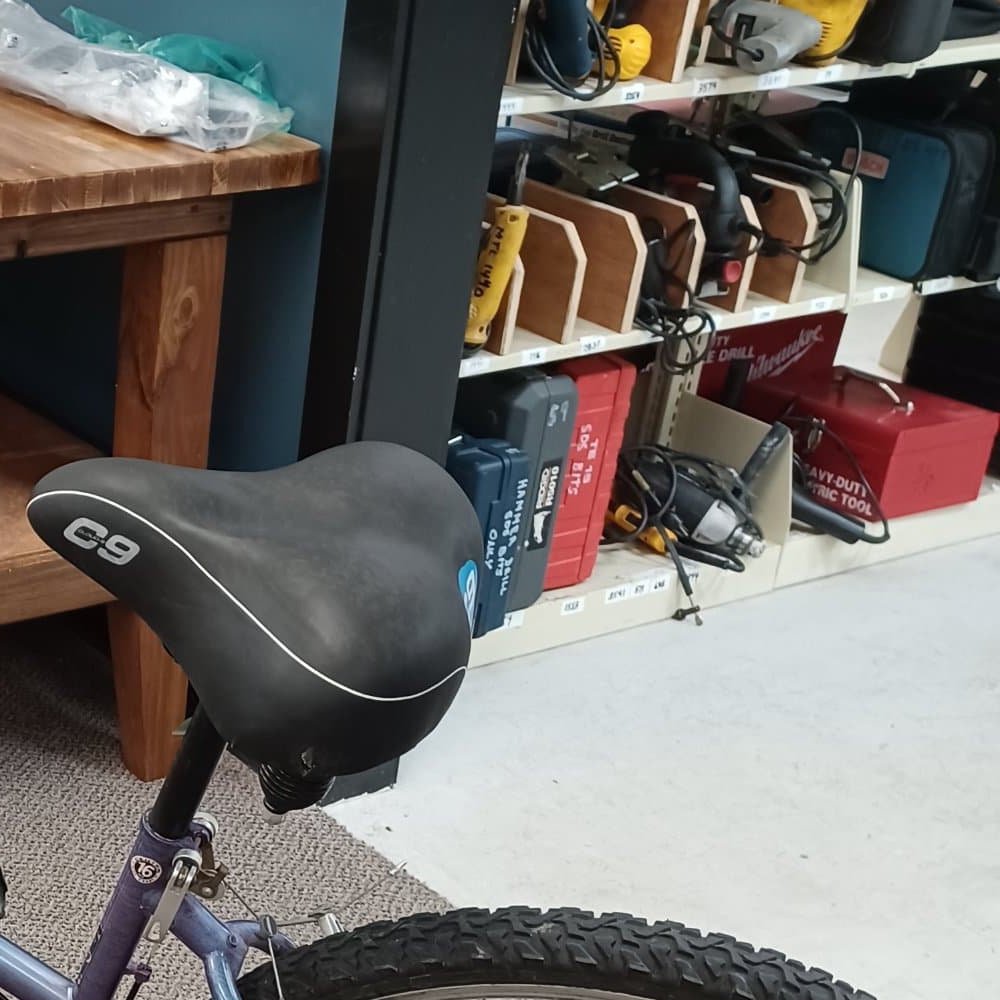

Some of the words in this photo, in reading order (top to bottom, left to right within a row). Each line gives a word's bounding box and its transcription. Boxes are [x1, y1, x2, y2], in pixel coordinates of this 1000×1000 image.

[718, 344, 755, 362] DRILL
[576, 423, 593, 452] SDS
[567, 461, 584, 496] BITS
[509, 478, 529, 548] HAMMER
[841, 492, 873, 517] TOOL
[485, 528, 499, 570] ONLY
